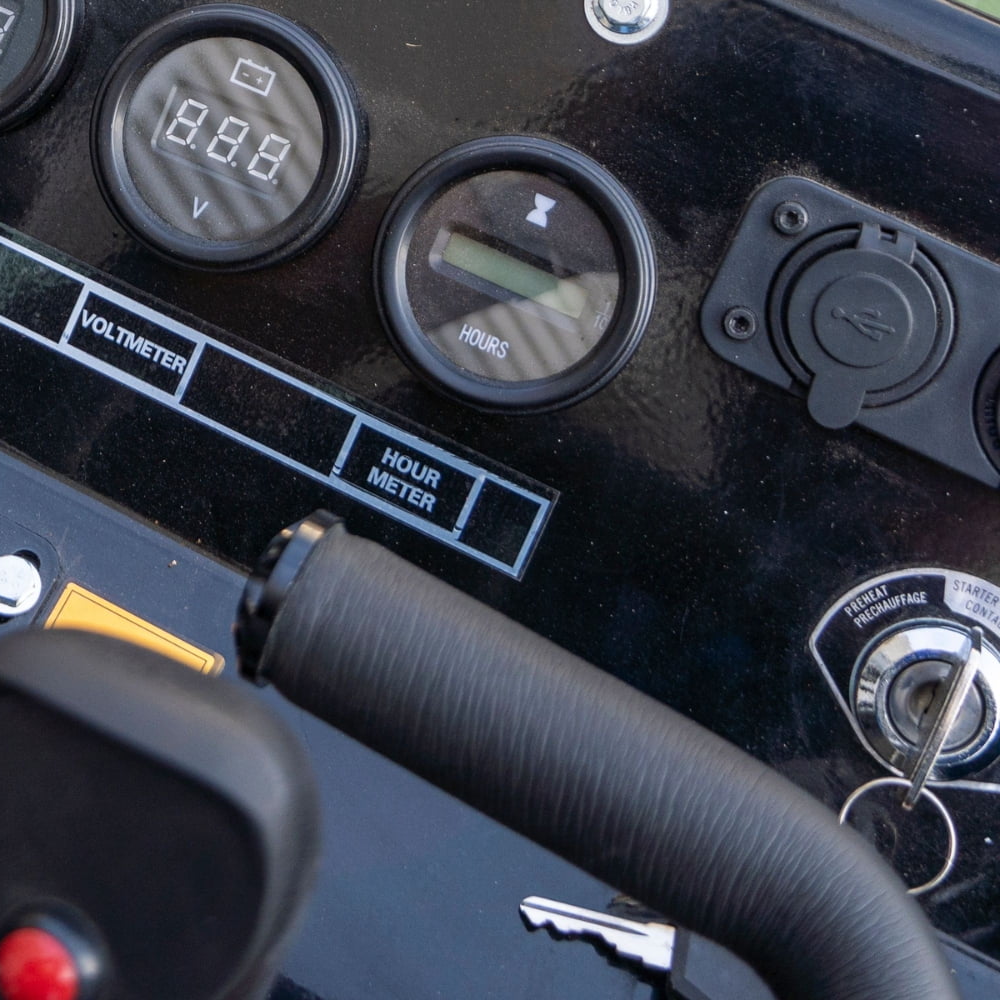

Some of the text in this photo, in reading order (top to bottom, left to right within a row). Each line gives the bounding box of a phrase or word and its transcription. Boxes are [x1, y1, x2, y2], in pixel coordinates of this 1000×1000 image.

[193, 196, 209, 219] V
[81, 309, 187, 374] VOLTMETER
[458, 323, 510, 359] HOURS
[381, 447, 442, 489] HOUR
[367, 465, 437, 513] METER
[844, 584, 889, 617] PREHEAT
[853, 591, 928, 628] PRECHAUFFAGE
[953, 580, 1000, 607] STARTER
